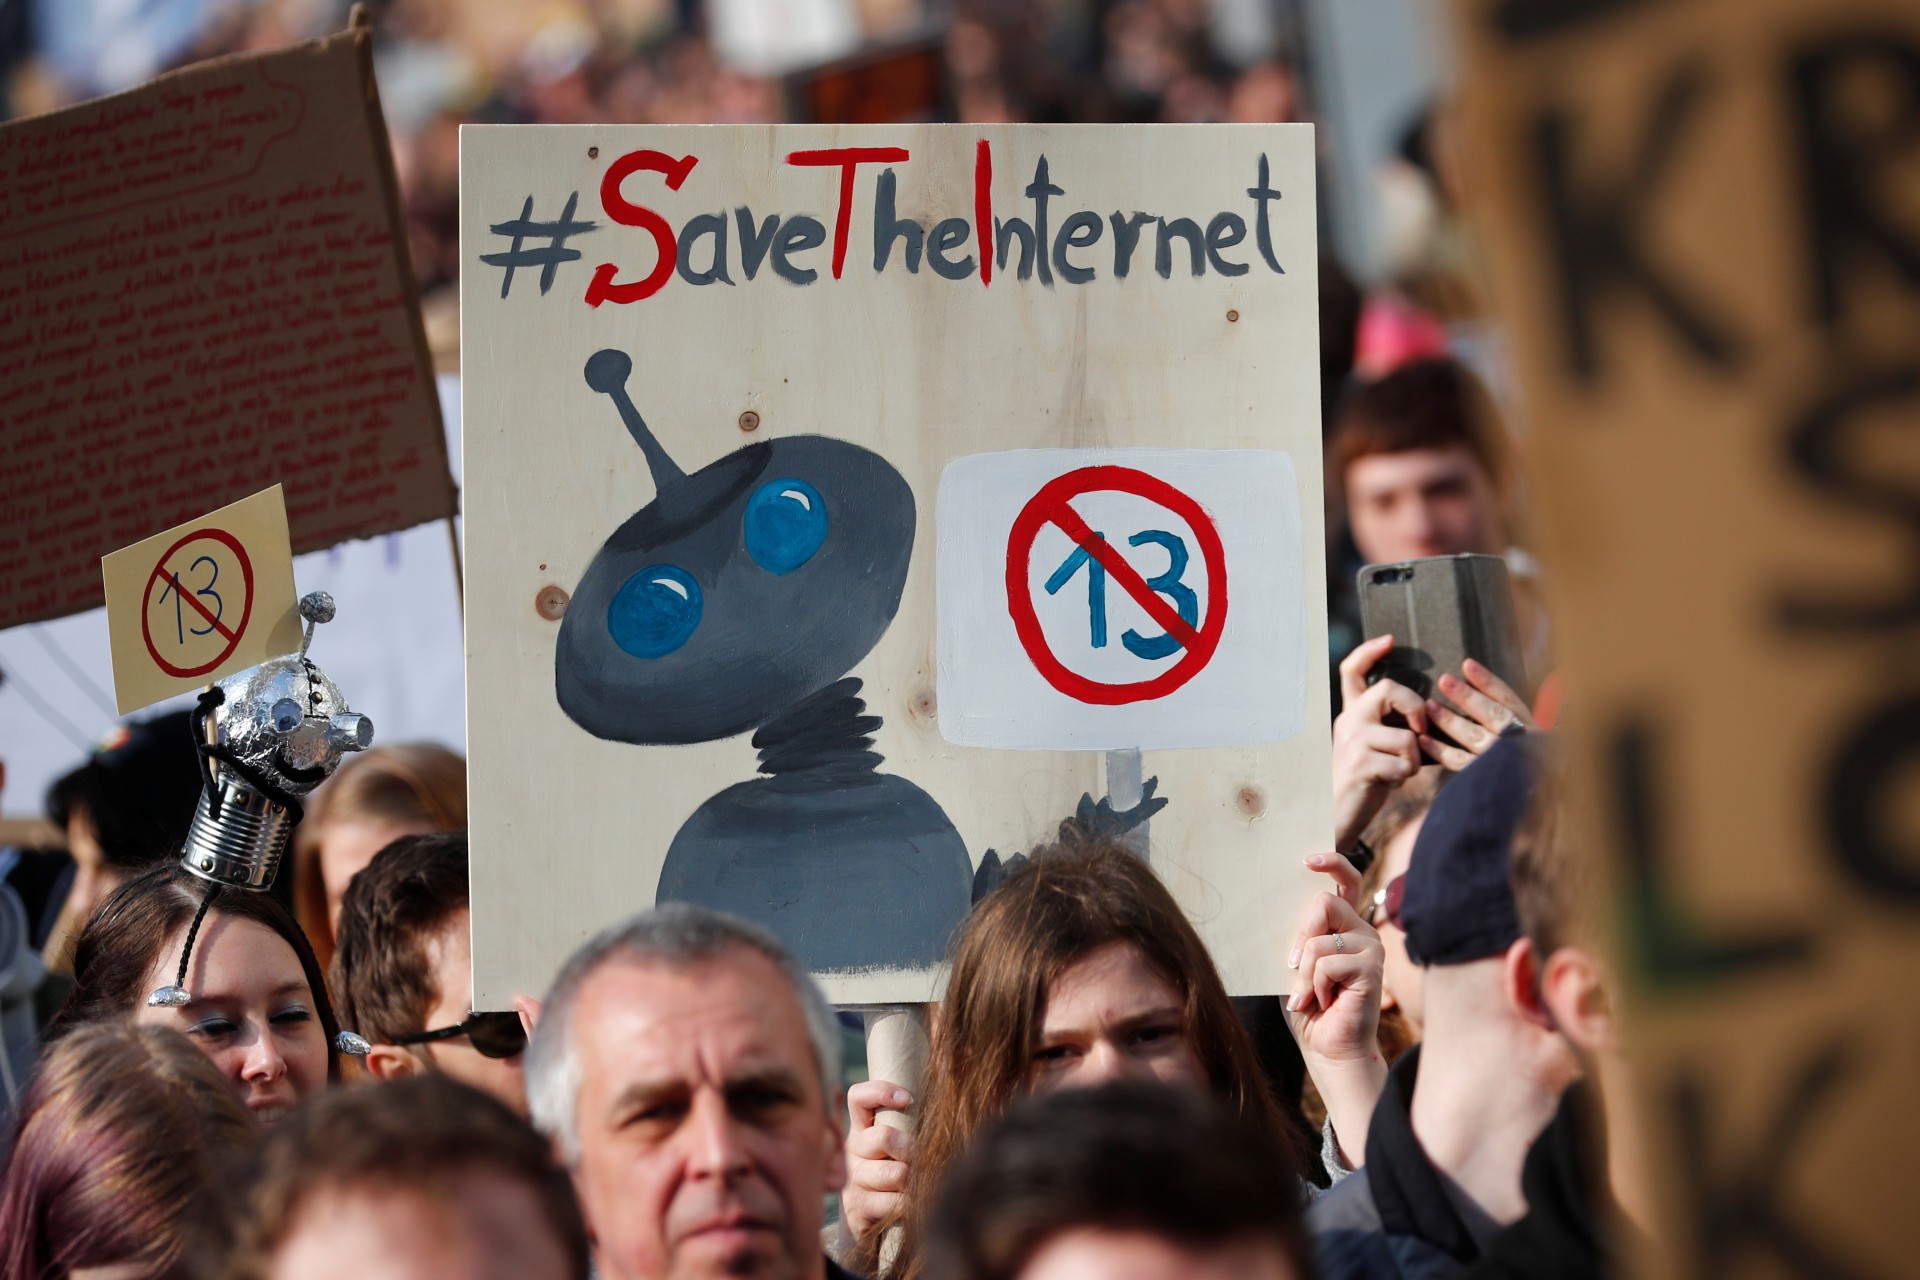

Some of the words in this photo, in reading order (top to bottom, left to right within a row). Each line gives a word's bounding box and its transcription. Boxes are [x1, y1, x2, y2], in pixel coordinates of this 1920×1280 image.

[479, 139, 1285, 308] #SaveTheInternet
[159, 556, 223, 644] 13
[1044, 529, 1199, 660] 13
